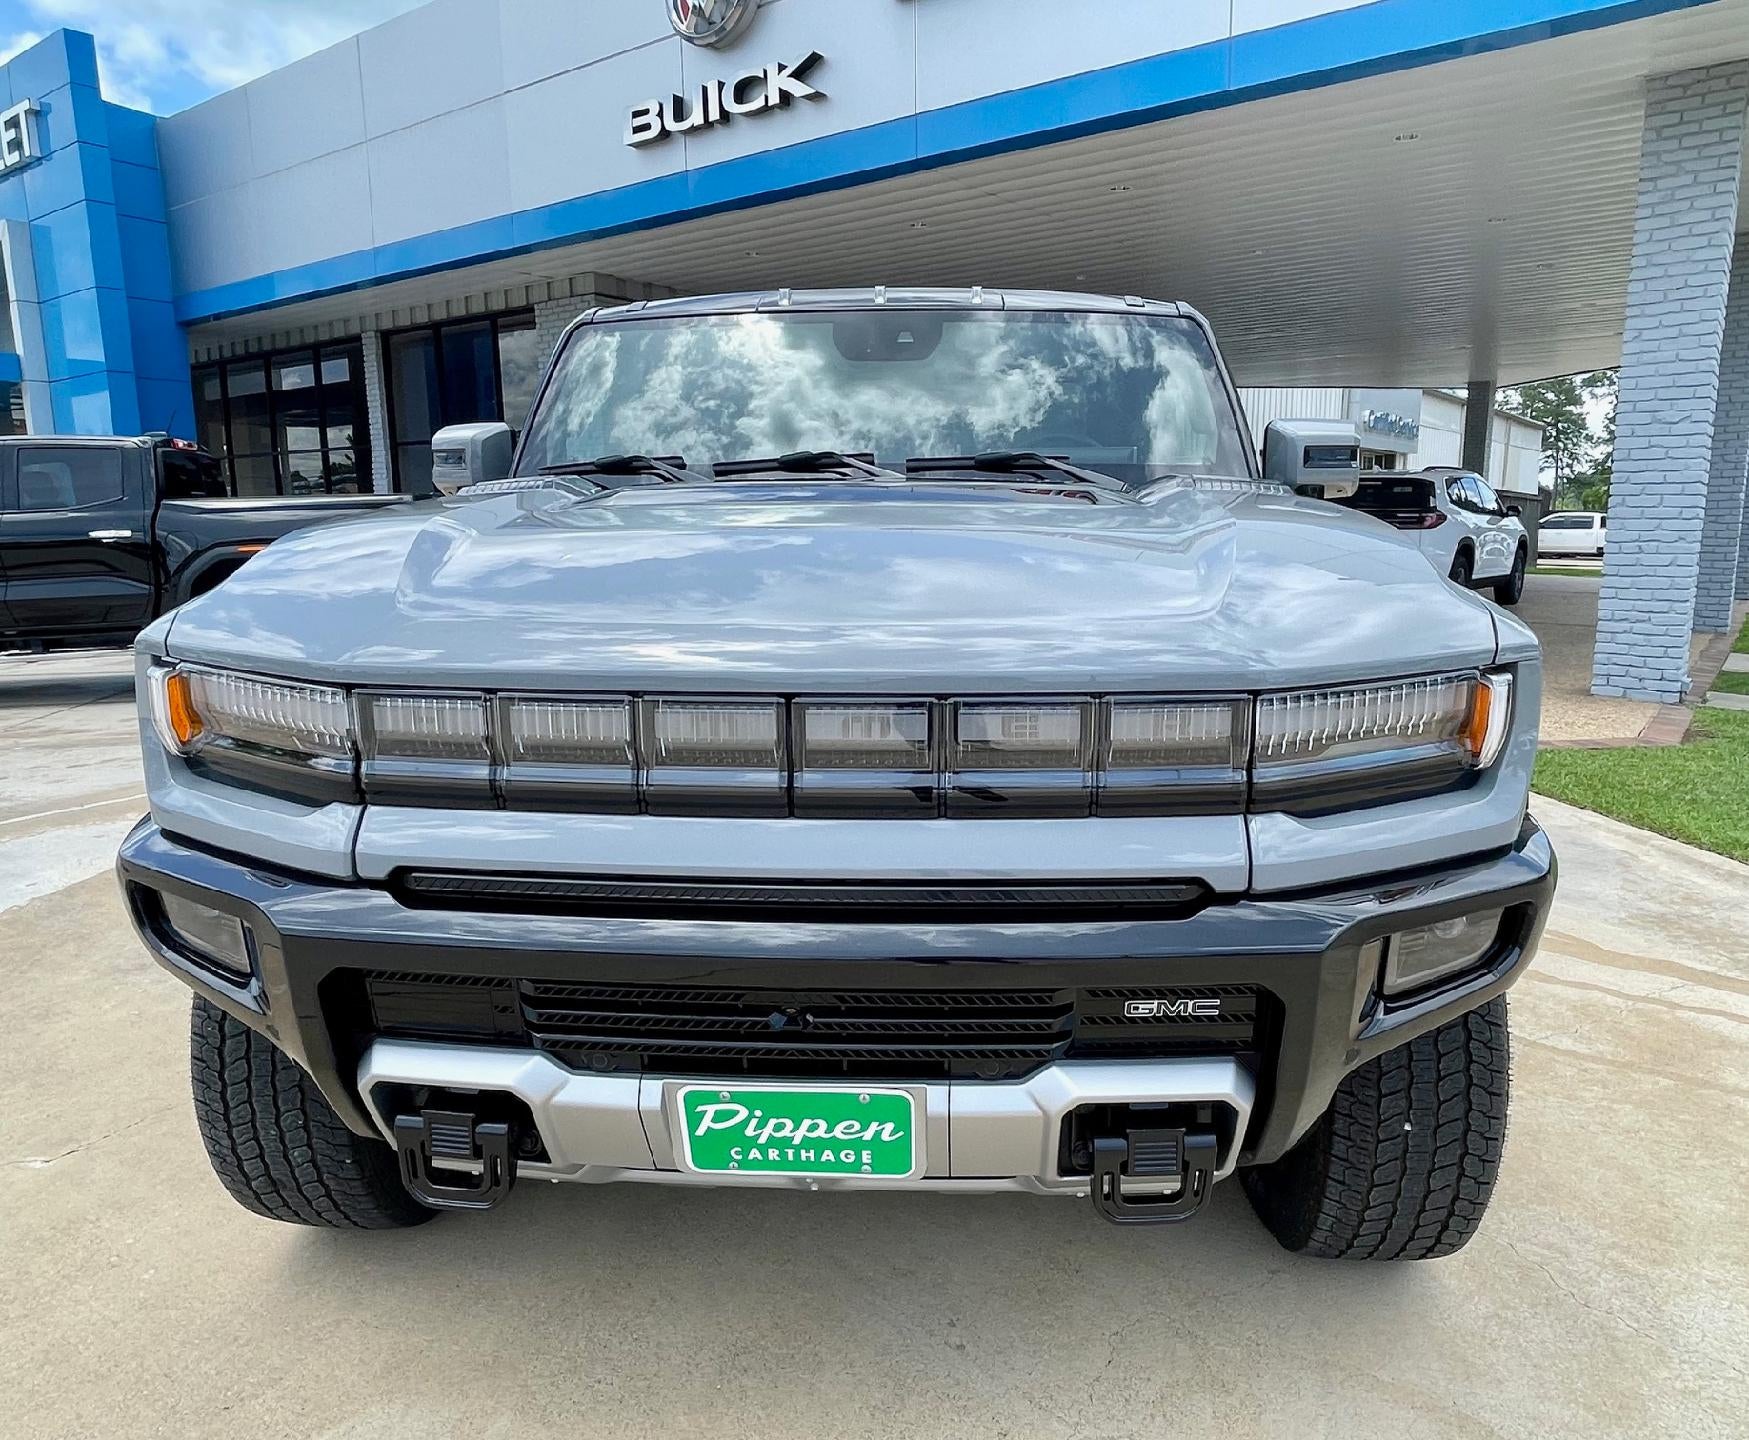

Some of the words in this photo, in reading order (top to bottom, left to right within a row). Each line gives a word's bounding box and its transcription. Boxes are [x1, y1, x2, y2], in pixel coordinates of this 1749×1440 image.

[623, 49, 828, 147] BUICK
[0, 97, 34, 170] ET
[1125, 999, 1220, 1017] GMC
[694, 1102, 905, 1145] Pippen
[730, 1147, 872, 1164] CARTHAGE
